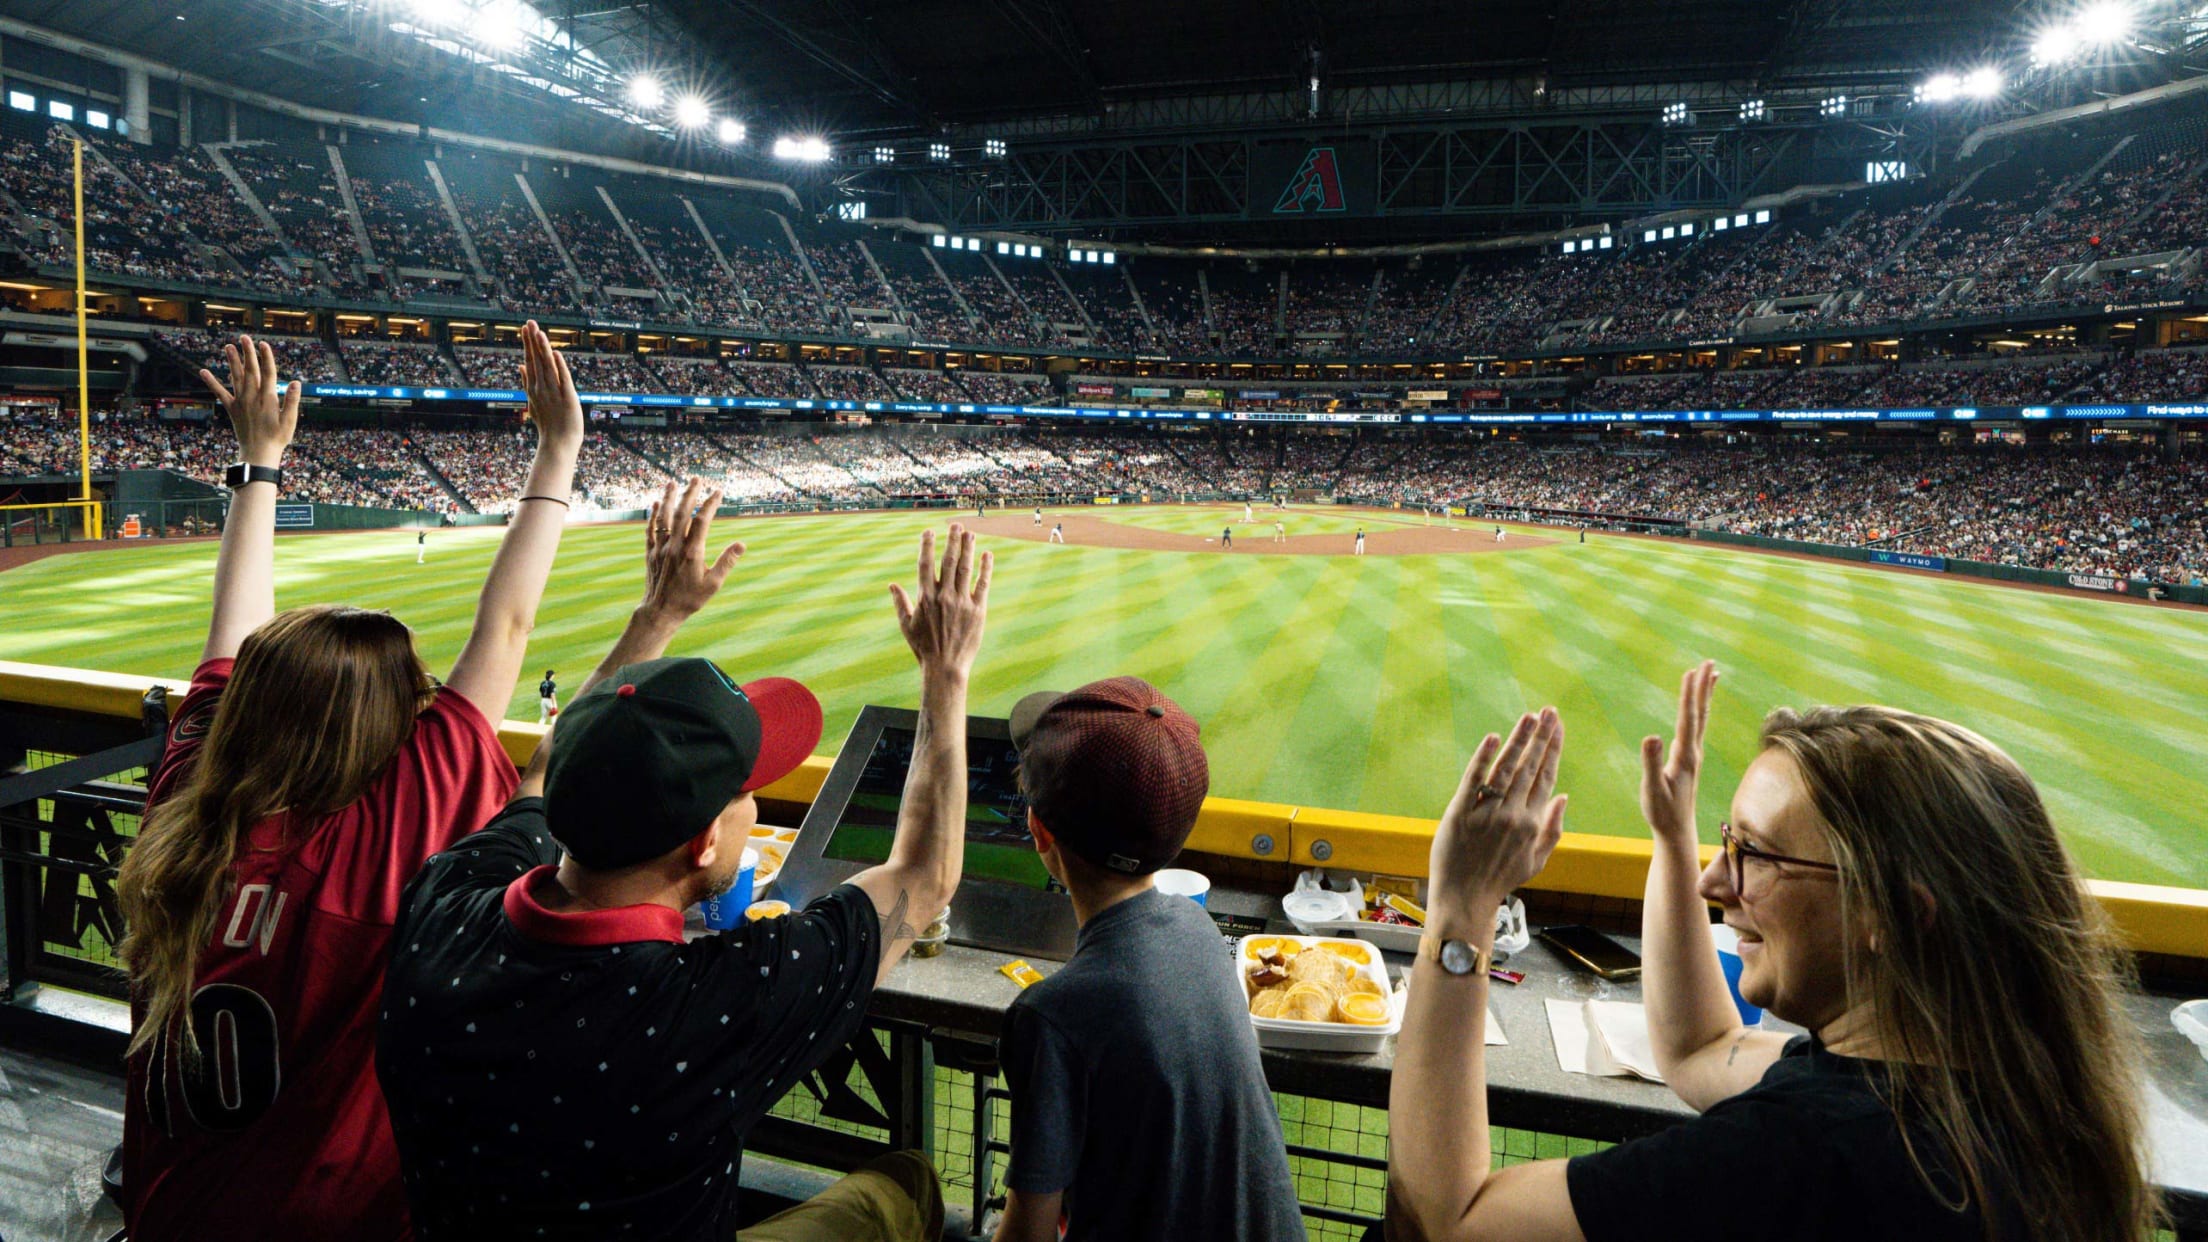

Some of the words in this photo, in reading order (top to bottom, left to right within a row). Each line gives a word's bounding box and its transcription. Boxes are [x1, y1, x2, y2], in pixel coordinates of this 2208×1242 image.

[315, 387, 337, 395] Every
[2146, 405, 2168, 415] Find
[2168, 407, 2193, 416] ways
[2194, 405, 2205, 414] to
[1899, 556, 1931, 566] WAYMO
[2068, 574, 2088, 584] COLD
[2088, 576, 2115, 589] STONE
